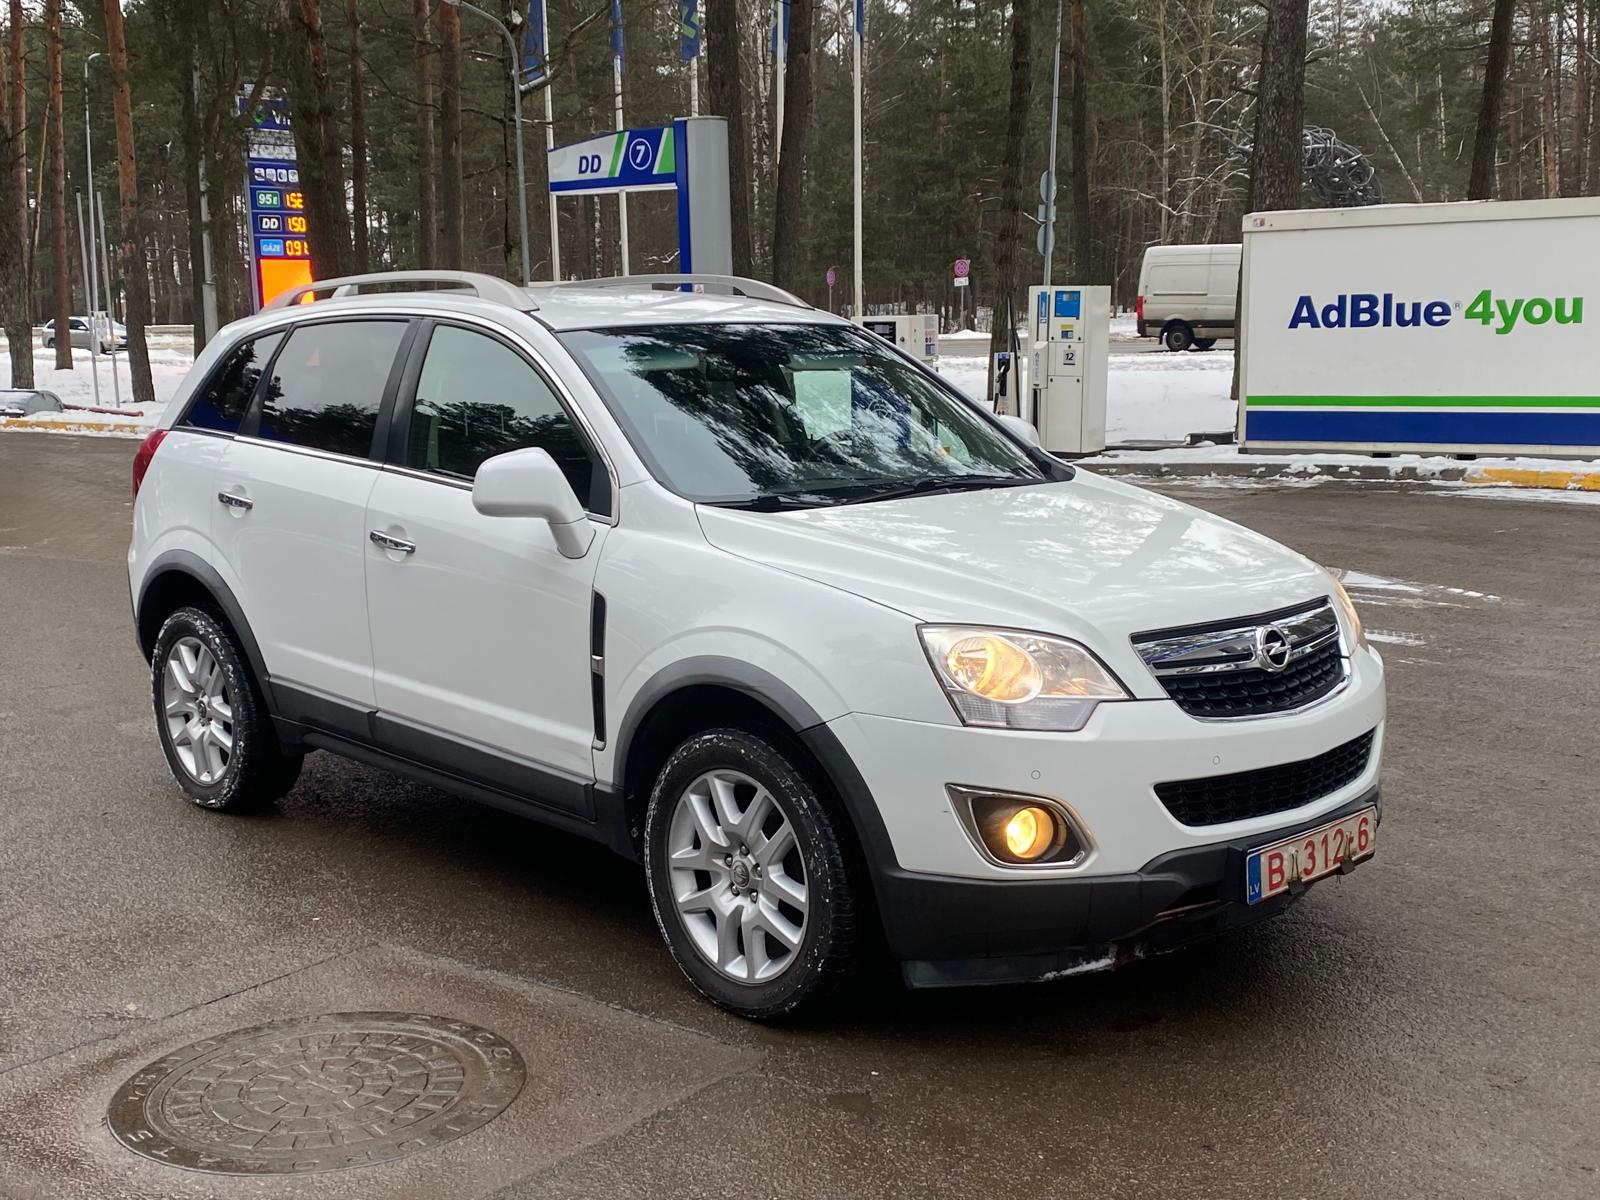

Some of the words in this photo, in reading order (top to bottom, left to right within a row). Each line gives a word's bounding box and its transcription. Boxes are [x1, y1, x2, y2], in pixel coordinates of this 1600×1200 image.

[635, 145, 646, 164] 7
[578, 154, 602, 174] DD
[262, 217, 279, 229] DD
[1464, 289, 1584, 335] 4you
[1065, 352, 1075, 361] 12
[1249, 882, 1261, 896] LV
